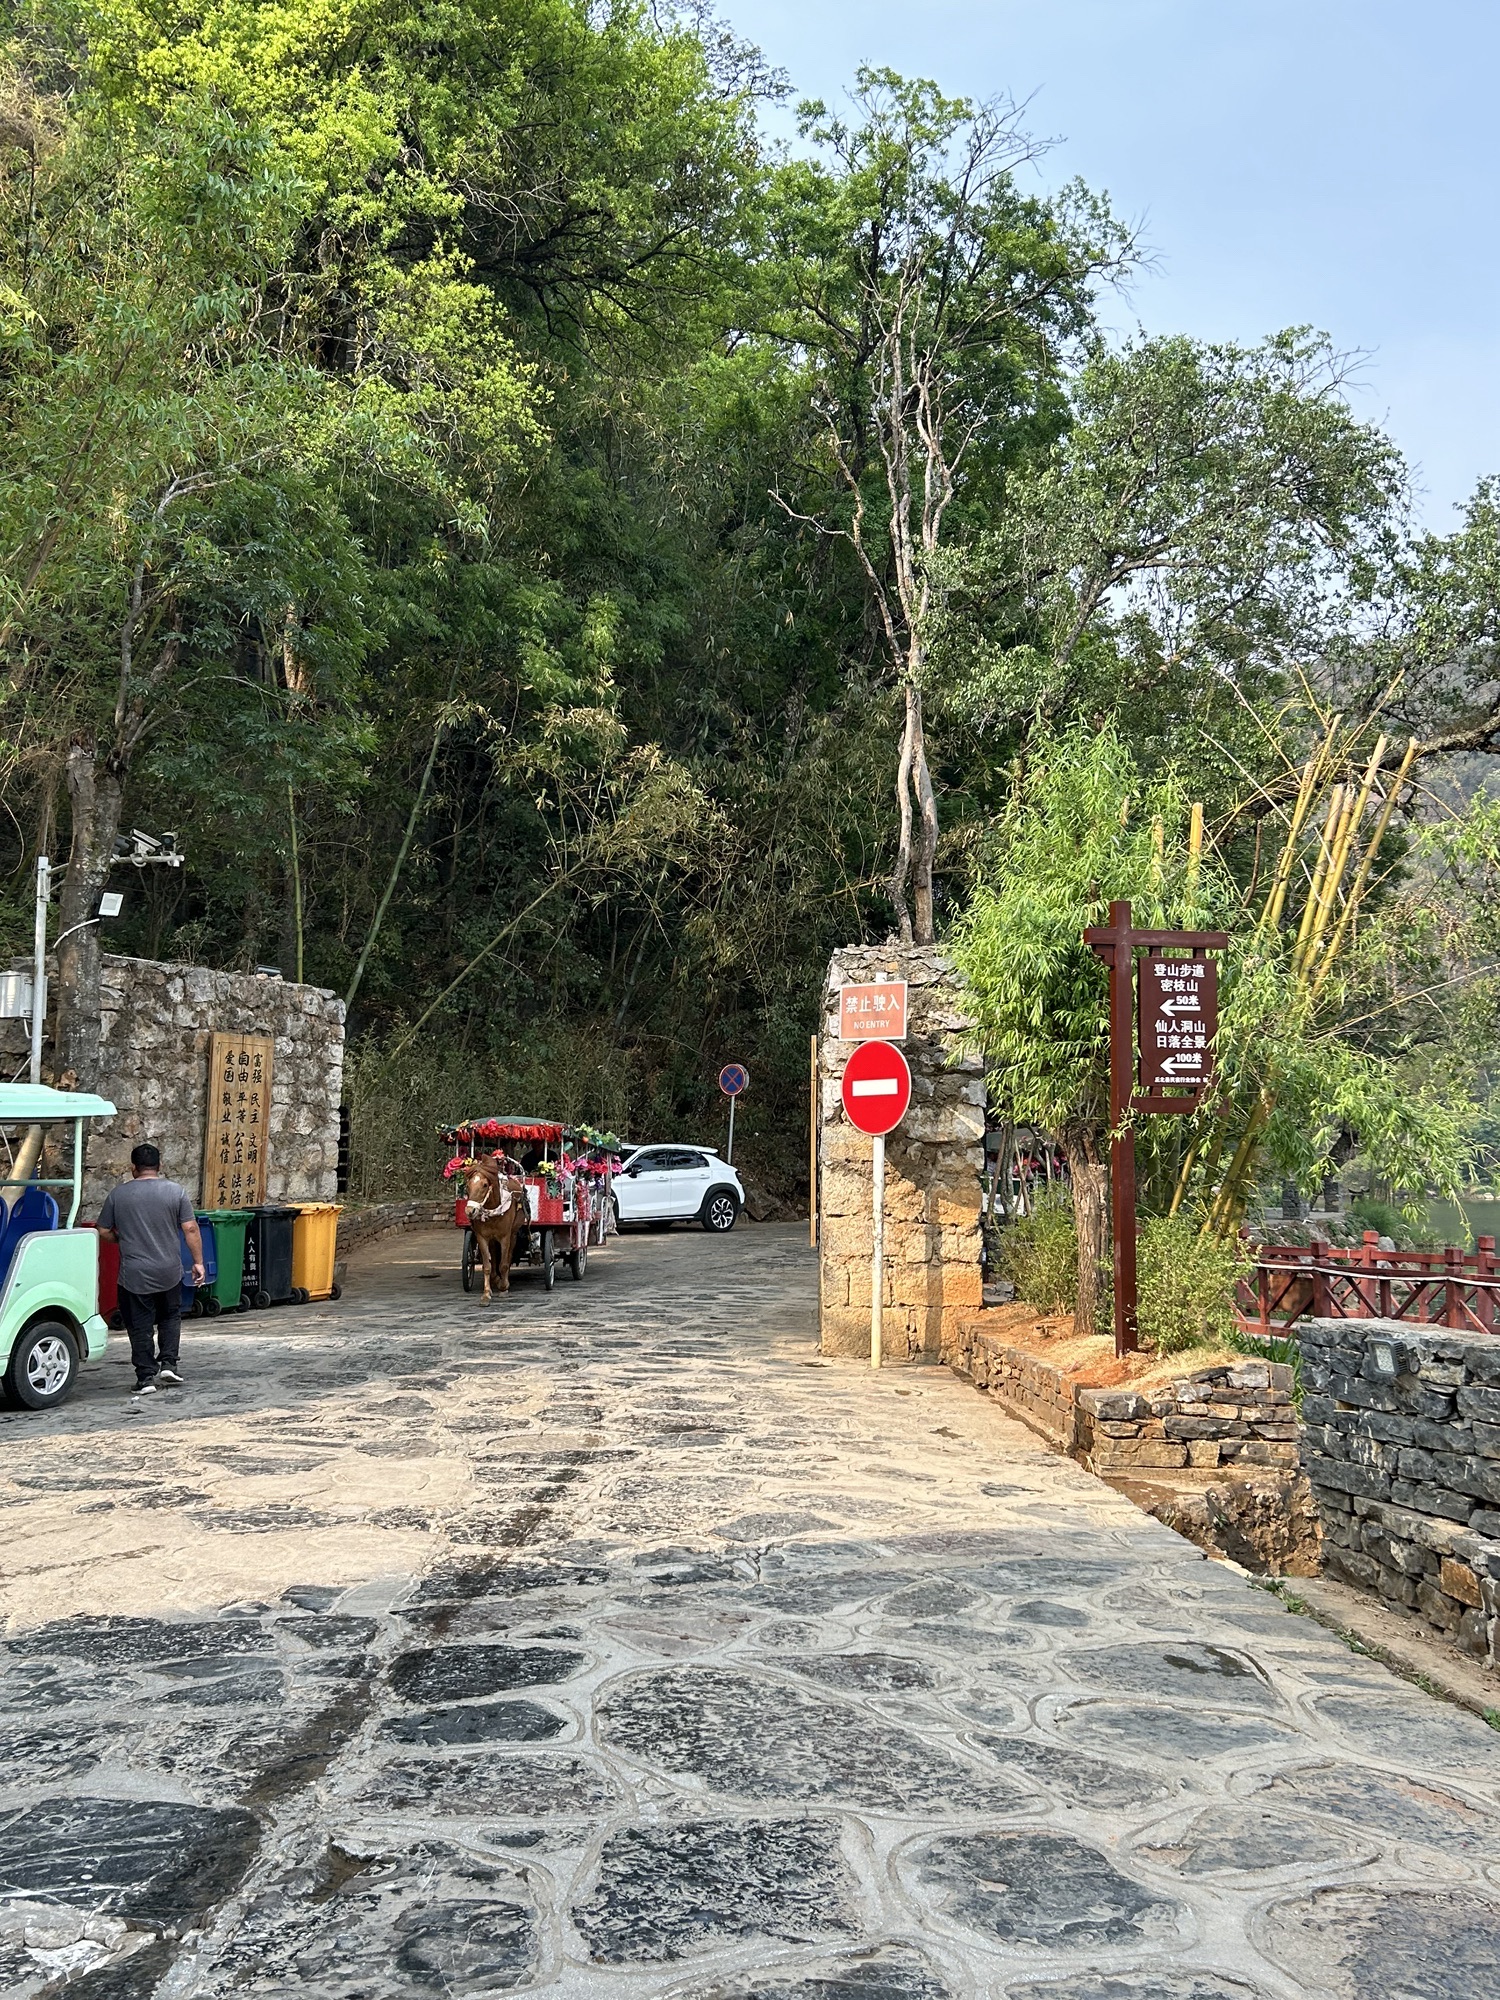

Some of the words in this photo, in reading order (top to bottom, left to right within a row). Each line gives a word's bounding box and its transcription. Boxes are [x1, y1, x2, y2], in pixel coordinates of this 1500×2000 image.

[1153, 963, 1205, 978] 登山步道
[1160, 978, 1199, 992] 密枝山
[845, 993, 900, 1014] 禁止驶入
[1176, 995, 1199, 1006] 50米
[853, 1021, 865, 1030] NO
[865, 1020, 890, 1029] ENTRY
[1155, 1019, 1206, 1033] 仙人洞山
[1156, 1034, 1206, 1049] 日落全景
[238, 1051, 250, 1083] 自由
[252, 1053, 263, 1083] 富强
[1175, 1052, 1203, 1064] 100米
[222, 1091, 232, 1123] 敬业
[236, 1092, 248, 1124] 平等
[249, 1093, 260, 1124] 民主
[220, 1132, 230, 1164] 诚信
[233, 1132, 245, 1164] 公正
[247, 1133, 258, 1164] 文明
[217, 1173, 227, 1205] 友善
[230, 1173, 241, 1205] 法治
[245, 1173, 256, 1204] 和谐
